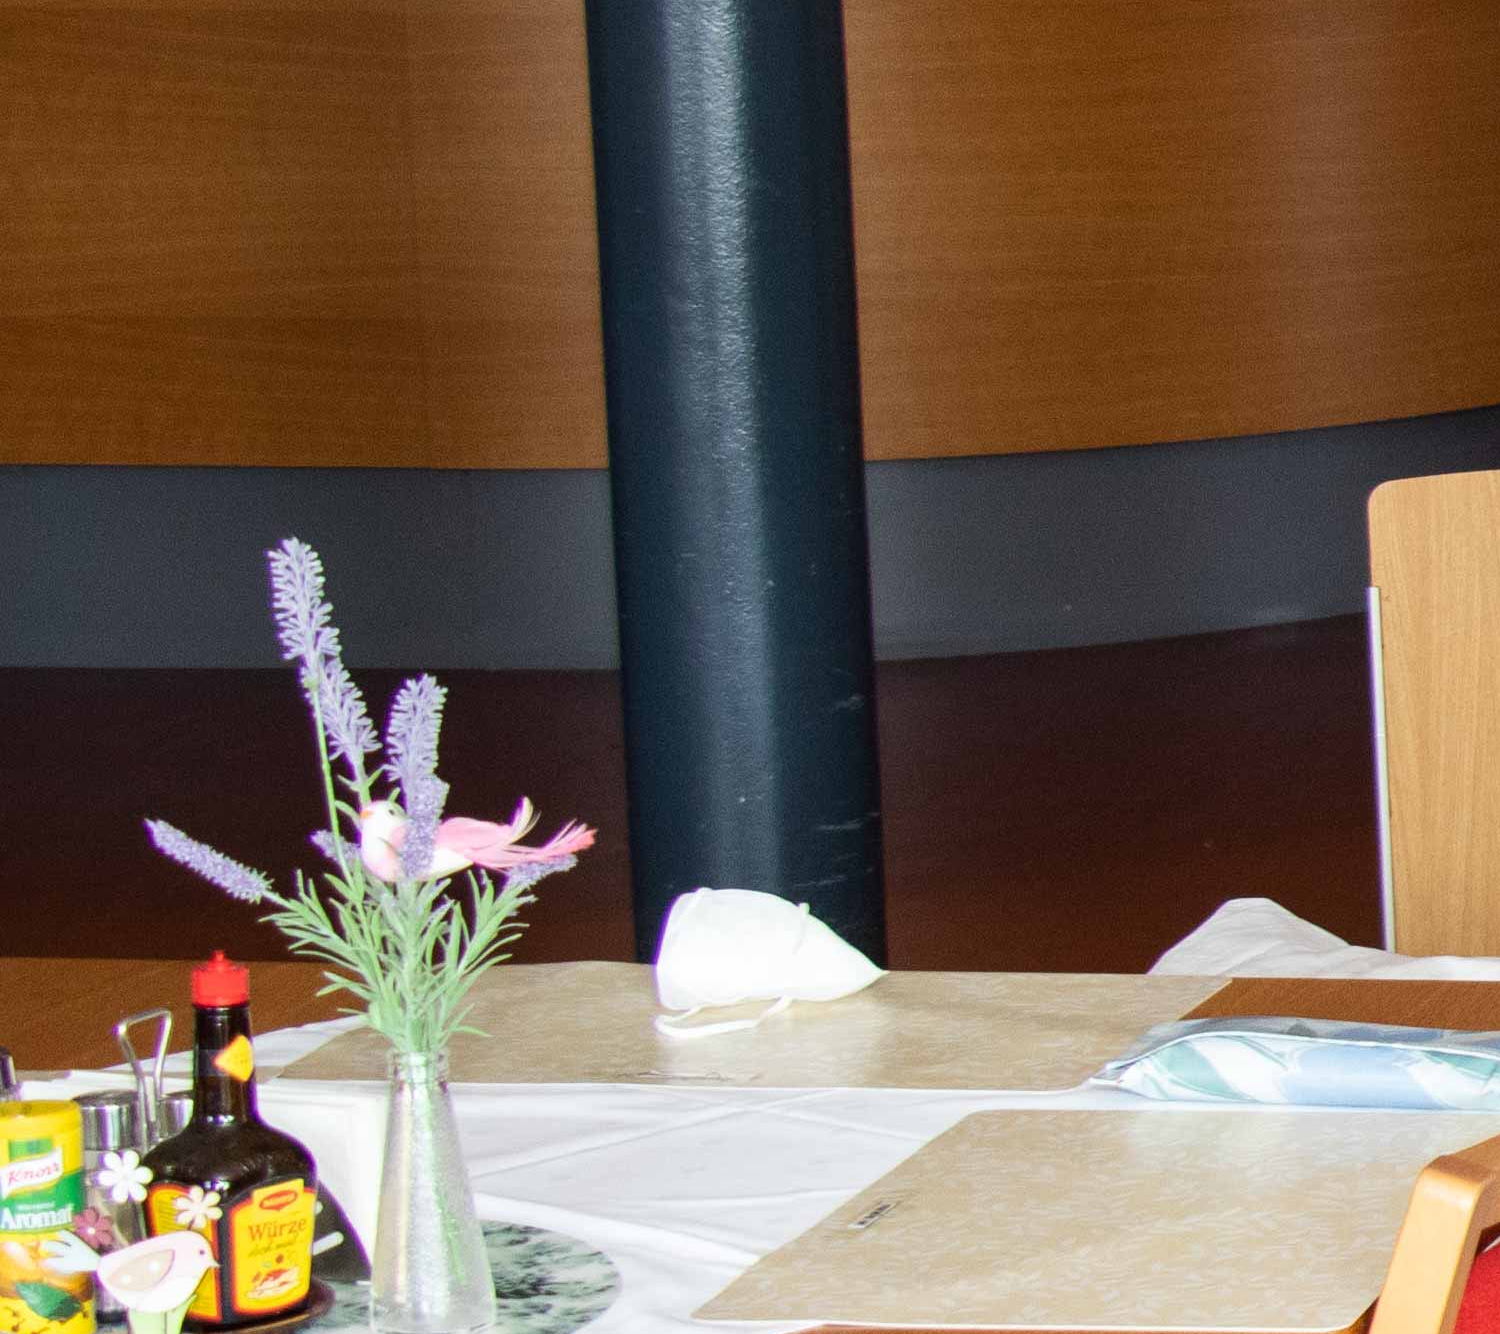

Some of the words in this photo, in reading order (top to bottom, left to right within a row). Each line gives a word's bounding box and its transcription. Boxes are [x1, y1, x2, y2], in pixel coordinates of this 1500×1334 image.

[7, 1163, 60, 1187] Knorr
[0, 1204, 74, 1230] Aromat
[247, 1218, 306, 1242] Würze
